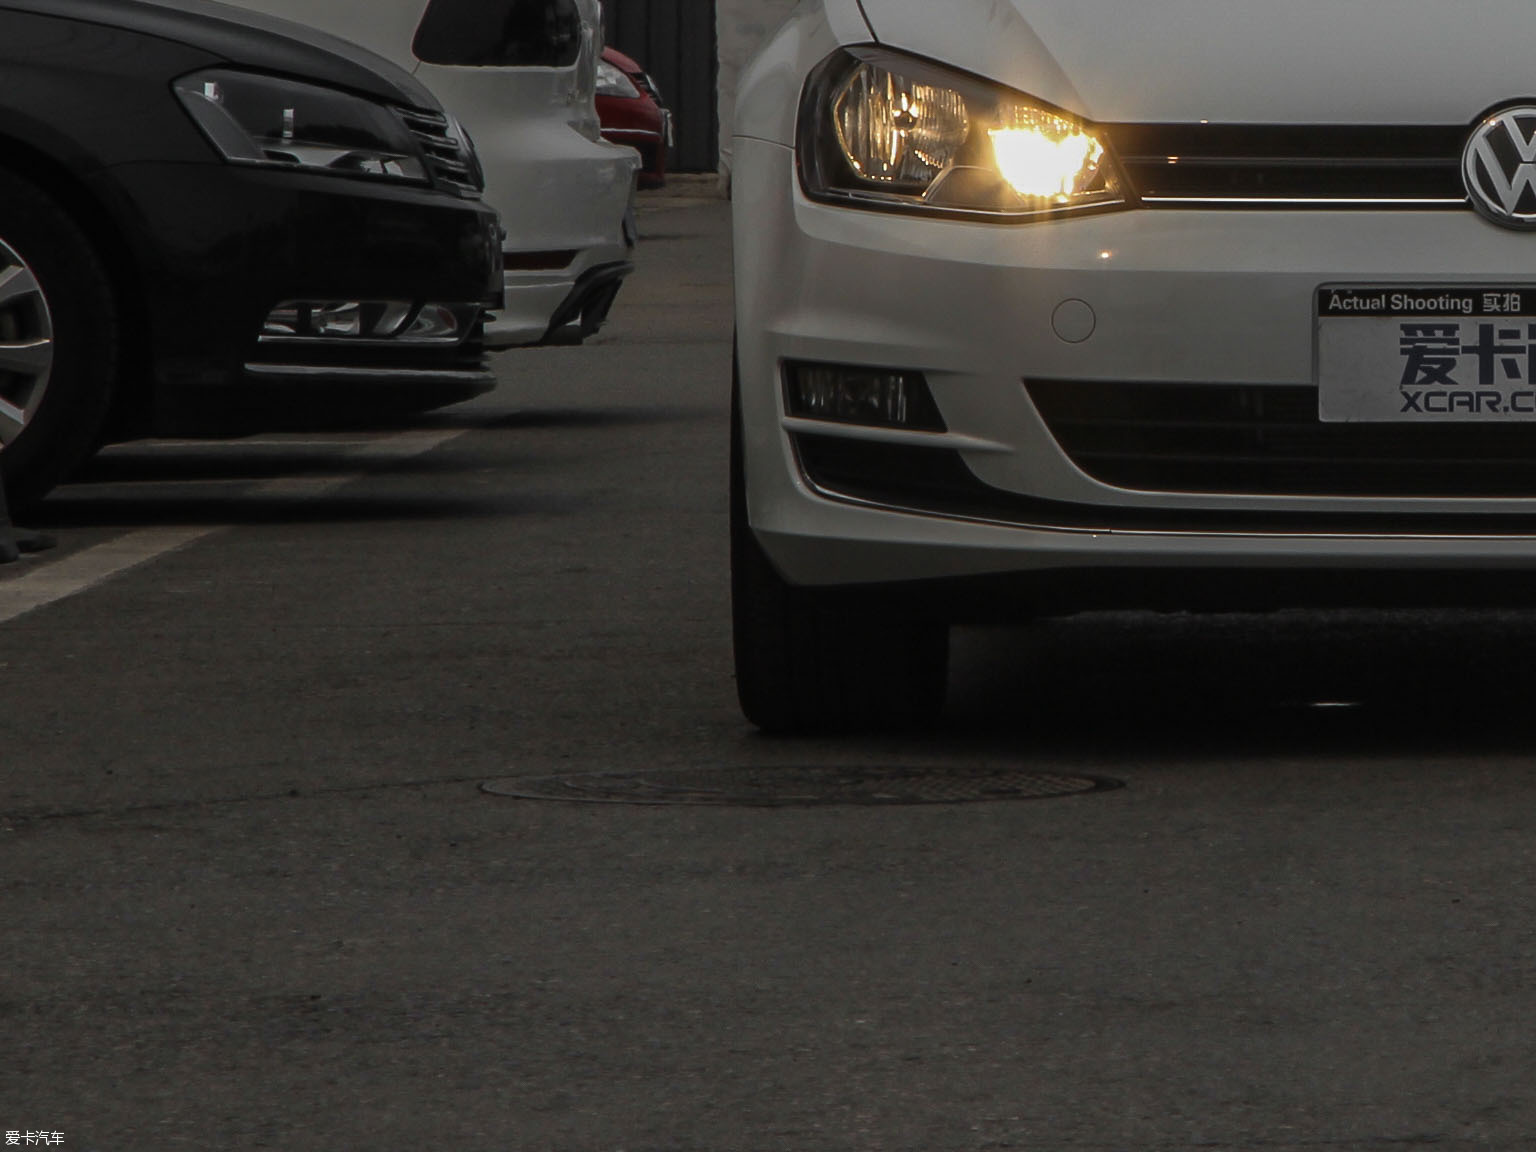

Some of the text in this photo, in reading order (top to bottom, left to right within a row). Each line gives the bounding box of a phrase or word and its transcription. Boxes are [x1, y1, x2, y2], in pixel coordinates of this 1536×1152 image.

[1329, 294, 1521, 313] Actual Shooting 实拍
